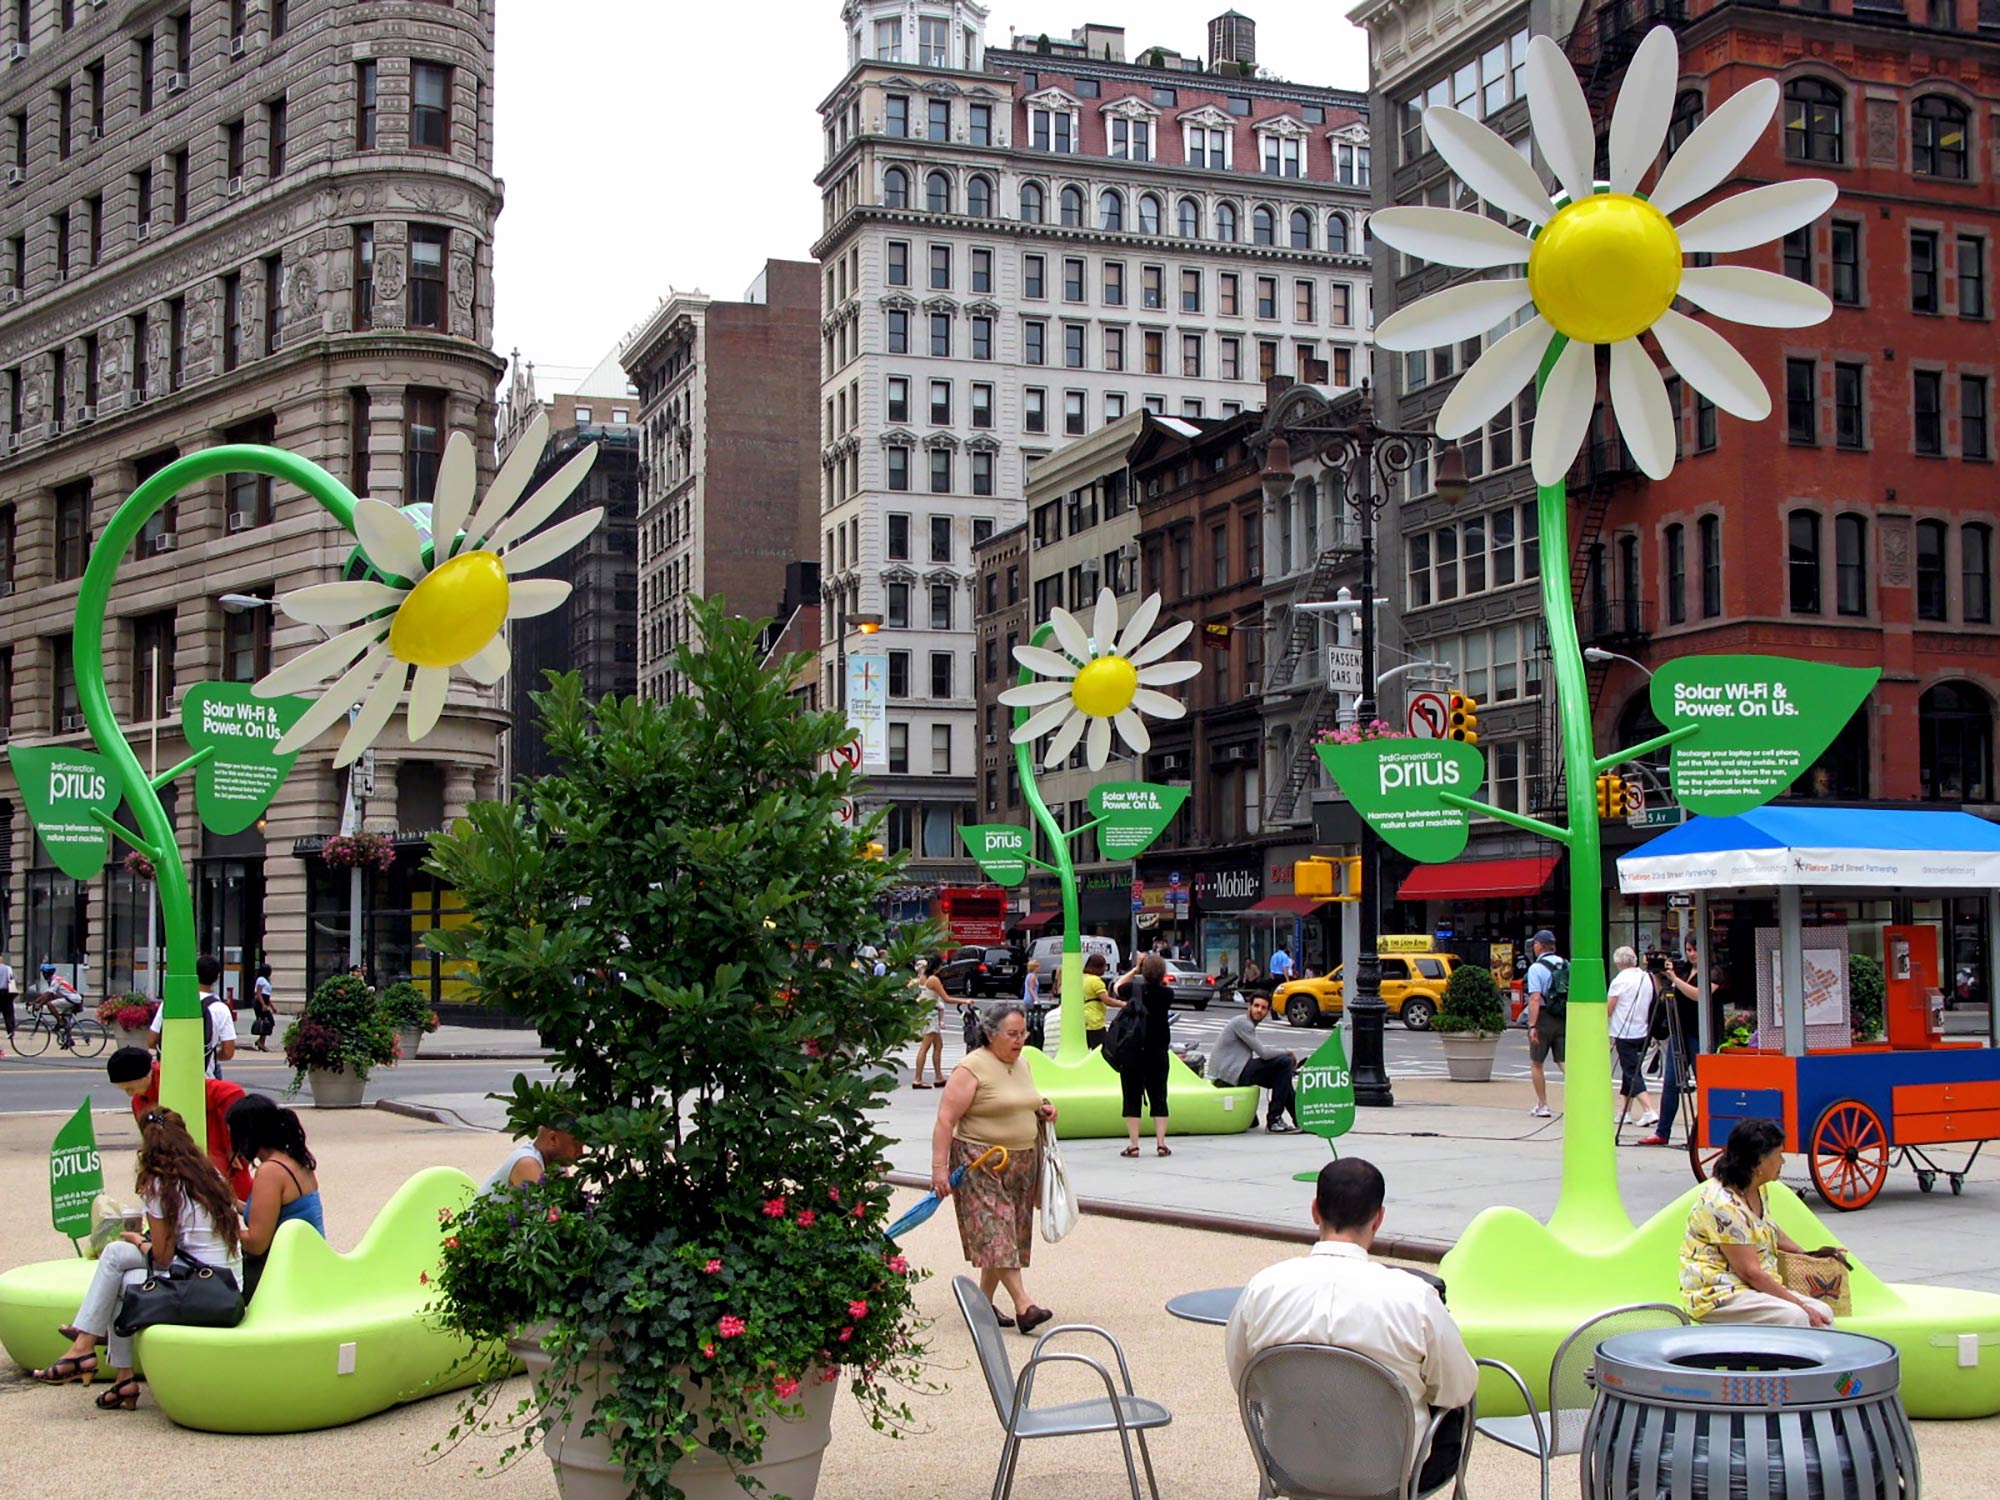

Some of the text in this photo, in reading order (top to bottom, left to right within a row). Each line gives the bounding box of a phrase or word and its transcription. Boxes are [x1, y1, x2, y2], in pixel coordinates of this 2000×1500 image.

[1331, 670, 1351, 685] CARS
[1674, 682, 1787, 699] Solar Wi-Fi &
[203, 699, 278, 722] Solar Wi-Fi &
[1674, 699, 1799, 717] Power. On Us.
[203, 717, 284, 741] Power. On Us.
[1378, 752, 1442, 762] 3rdGeneration
[1677, 750, 1711, 758] Recharge
[1775, 749, 1801, 757] phone,
[1736, 759, 1751, 767] stay
[1379, 760, 1460, 795] prius
[1677, 769, 1709, 777] powered
[1725, 768, 1742, 776] help
[1703, 778, 1733, 786] optional
[49, 772, 106, 805] prius
[1703, 787, 1742, 796] generation
[1102, 792, 1157, 801] Solar Wi-Fi &
[1102, 800, 1162, 809] Power. On Us.
[1367, 811, 1404, 820] Harmony
[1405, 810, 1441, 818] between
[38, 822, 64, 832] Harmony
[64, 823, 89, 832] between
[1381, 818, 1463, 829] nature and machine.
[985, 835, 1023, 852] prius
[1302, 1071, 1350, 1095] prius
[51, 1151, 100, 1185] prius
